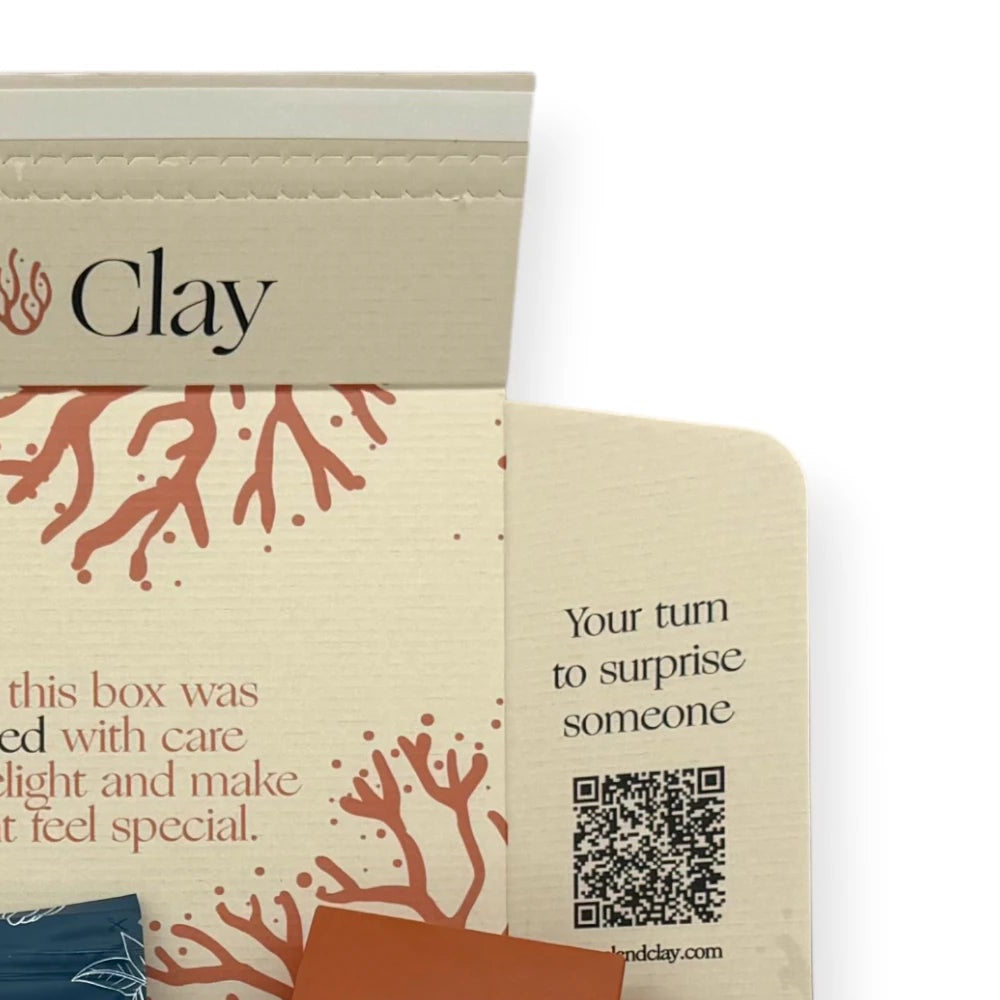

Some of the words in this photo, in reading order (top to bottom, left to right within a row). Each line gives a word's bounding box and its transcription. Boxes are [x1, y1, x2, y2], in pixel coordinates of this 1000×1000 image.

[71, 247, 278, 355] Clay
[564, 606, 643, 638] Your
[655, 598, 728, 628] turn
[553, 662, 587, 689] to
[599, 644, 746, 690] surprise
[8, 671, 78, 709] this
[92, 670, 165, 709] box
[180, 680, 259, 708] was
[61, 716, 146, 753] with
[161, 724, 248, 752] care
[563, 699, 735, 737] someone
[101, 760, 175, 798] and
[190, 759, 303, 797] make
[31, 805, 97, 843] feel
[111, 804, 259, 853] special.
